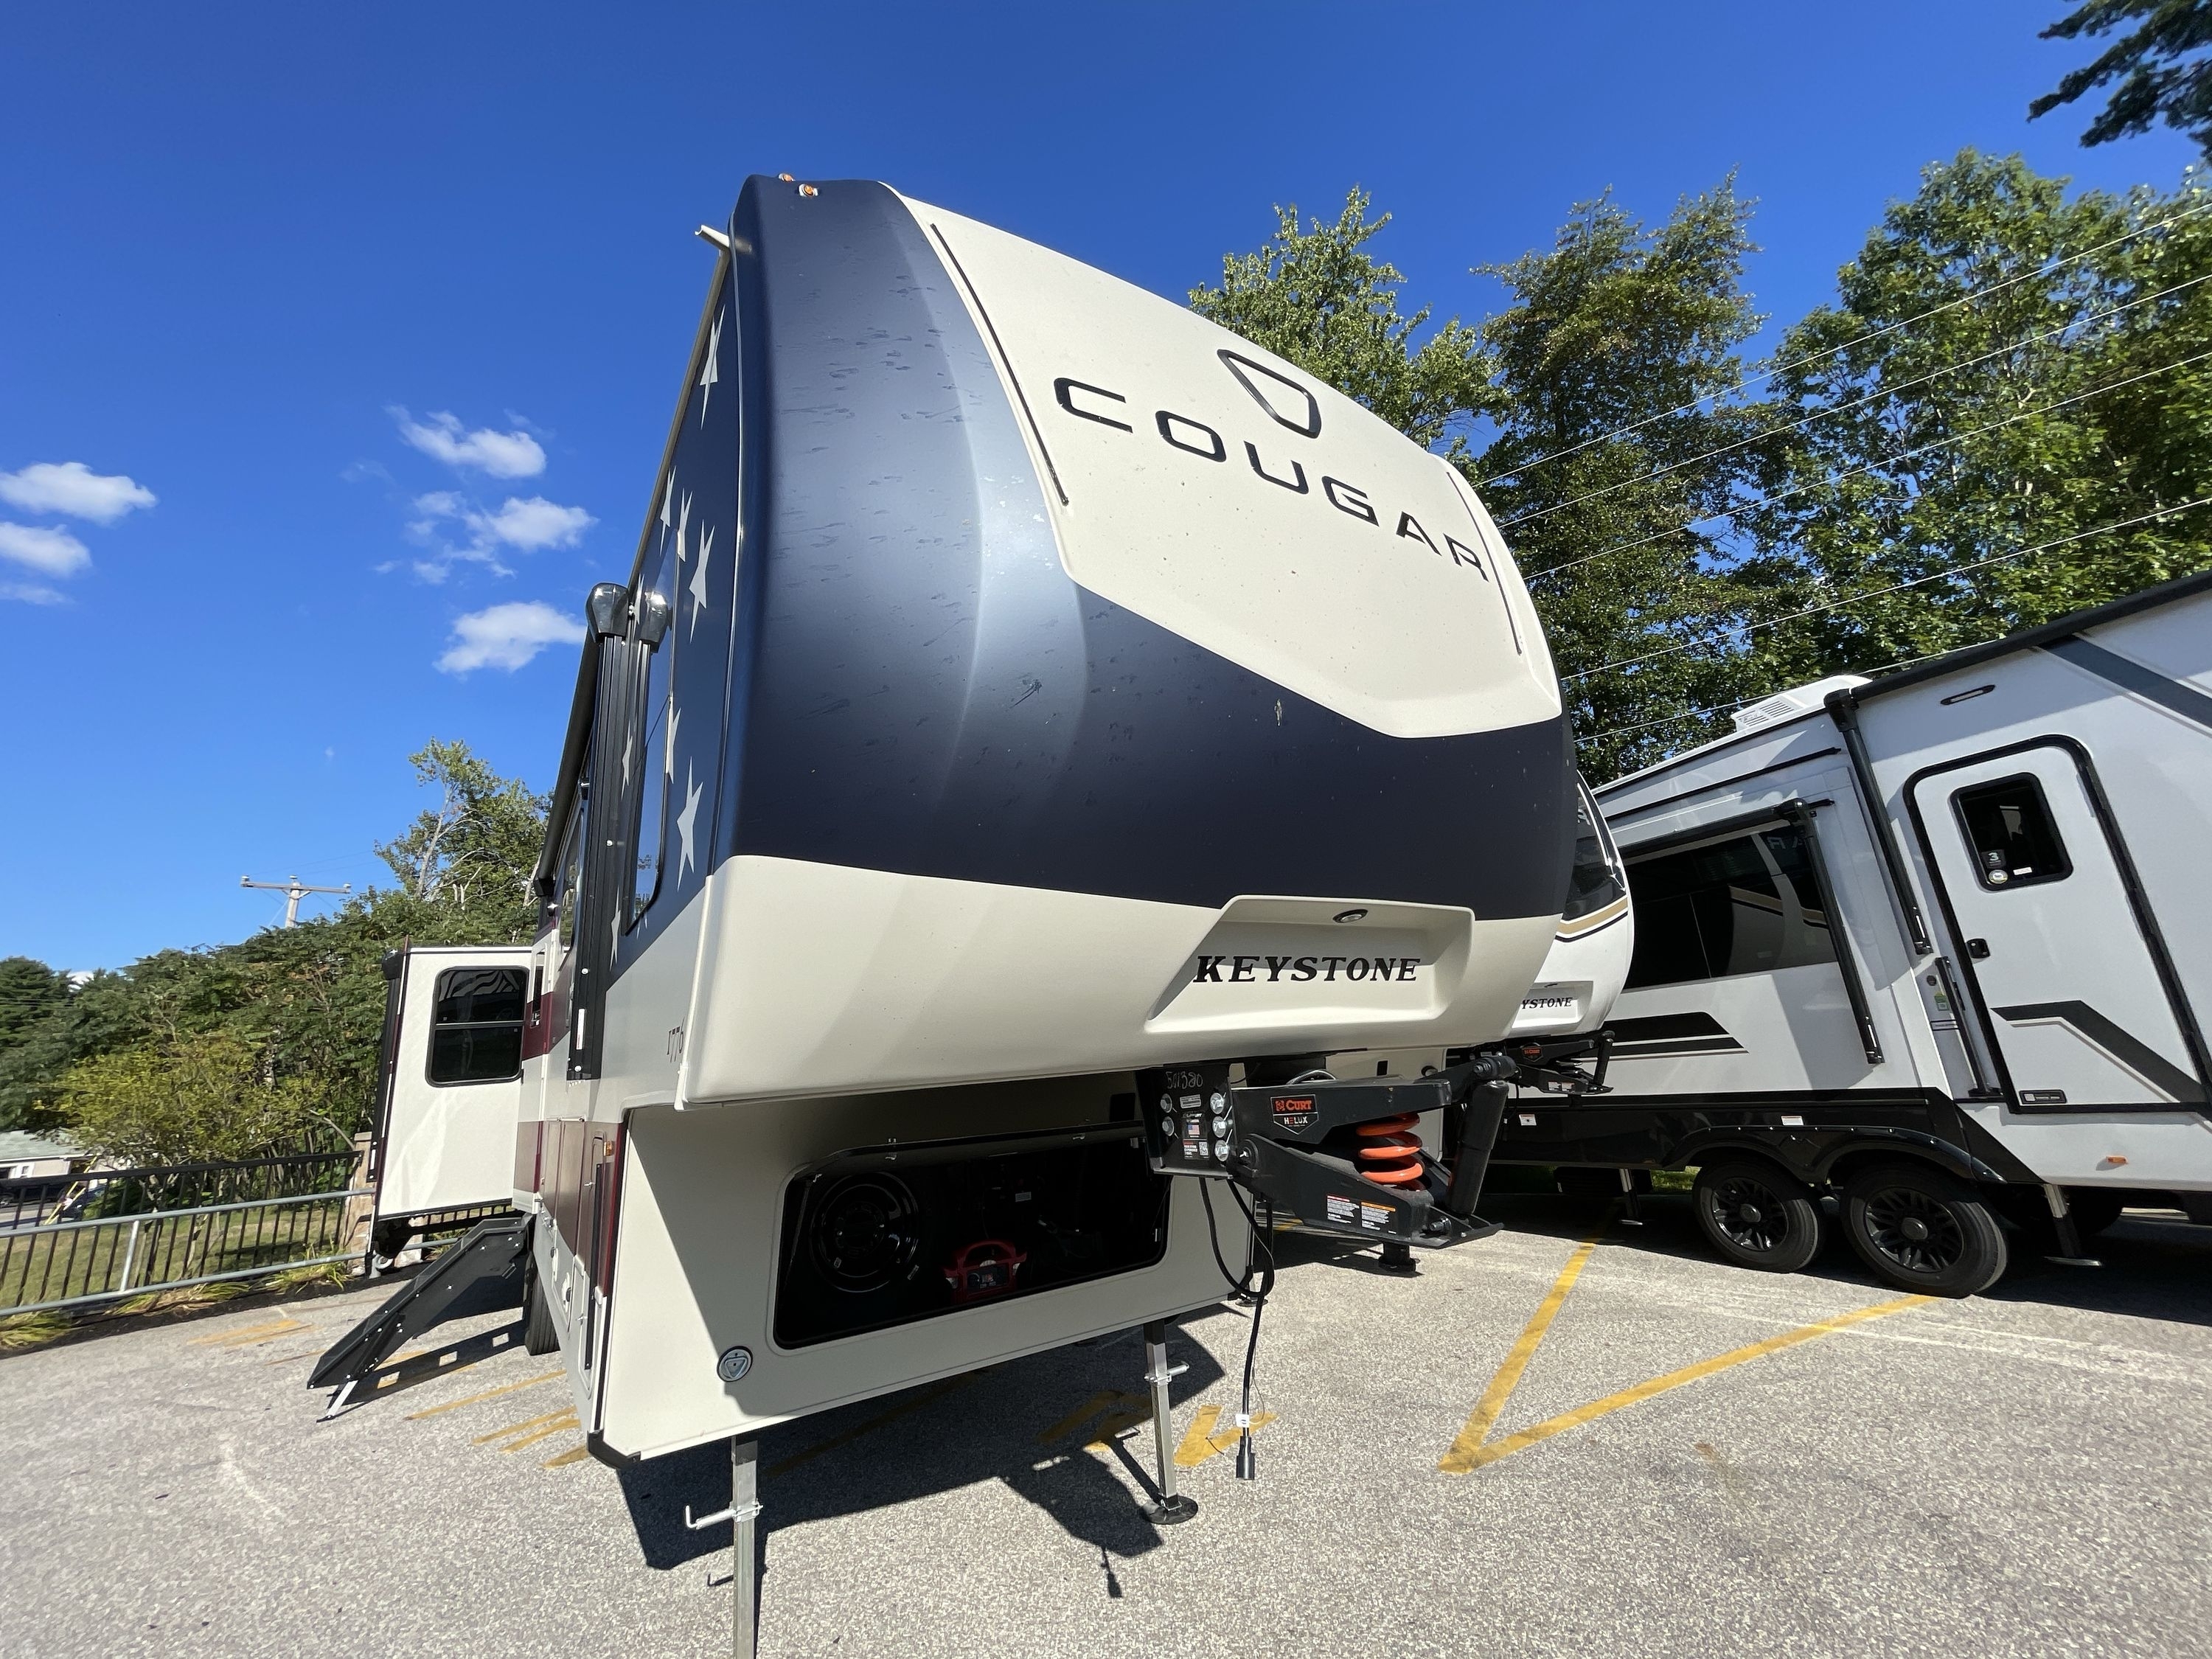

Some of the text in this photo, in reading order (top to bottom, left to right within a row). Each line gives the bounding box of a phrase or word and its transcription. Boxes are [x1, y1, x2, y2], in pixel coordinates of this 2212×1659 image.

[1053, 378, 1489, 582] COUGAR
[1989, 852, 1999, 861] 3
[1193, 956, 1421, 983] KEYSTONE
[1521, 997, 1573, 1009] YSTONE
[1286, 1099, 1312, 1111] CURT
[1284, 1116, 1308, 1125] HELUX
